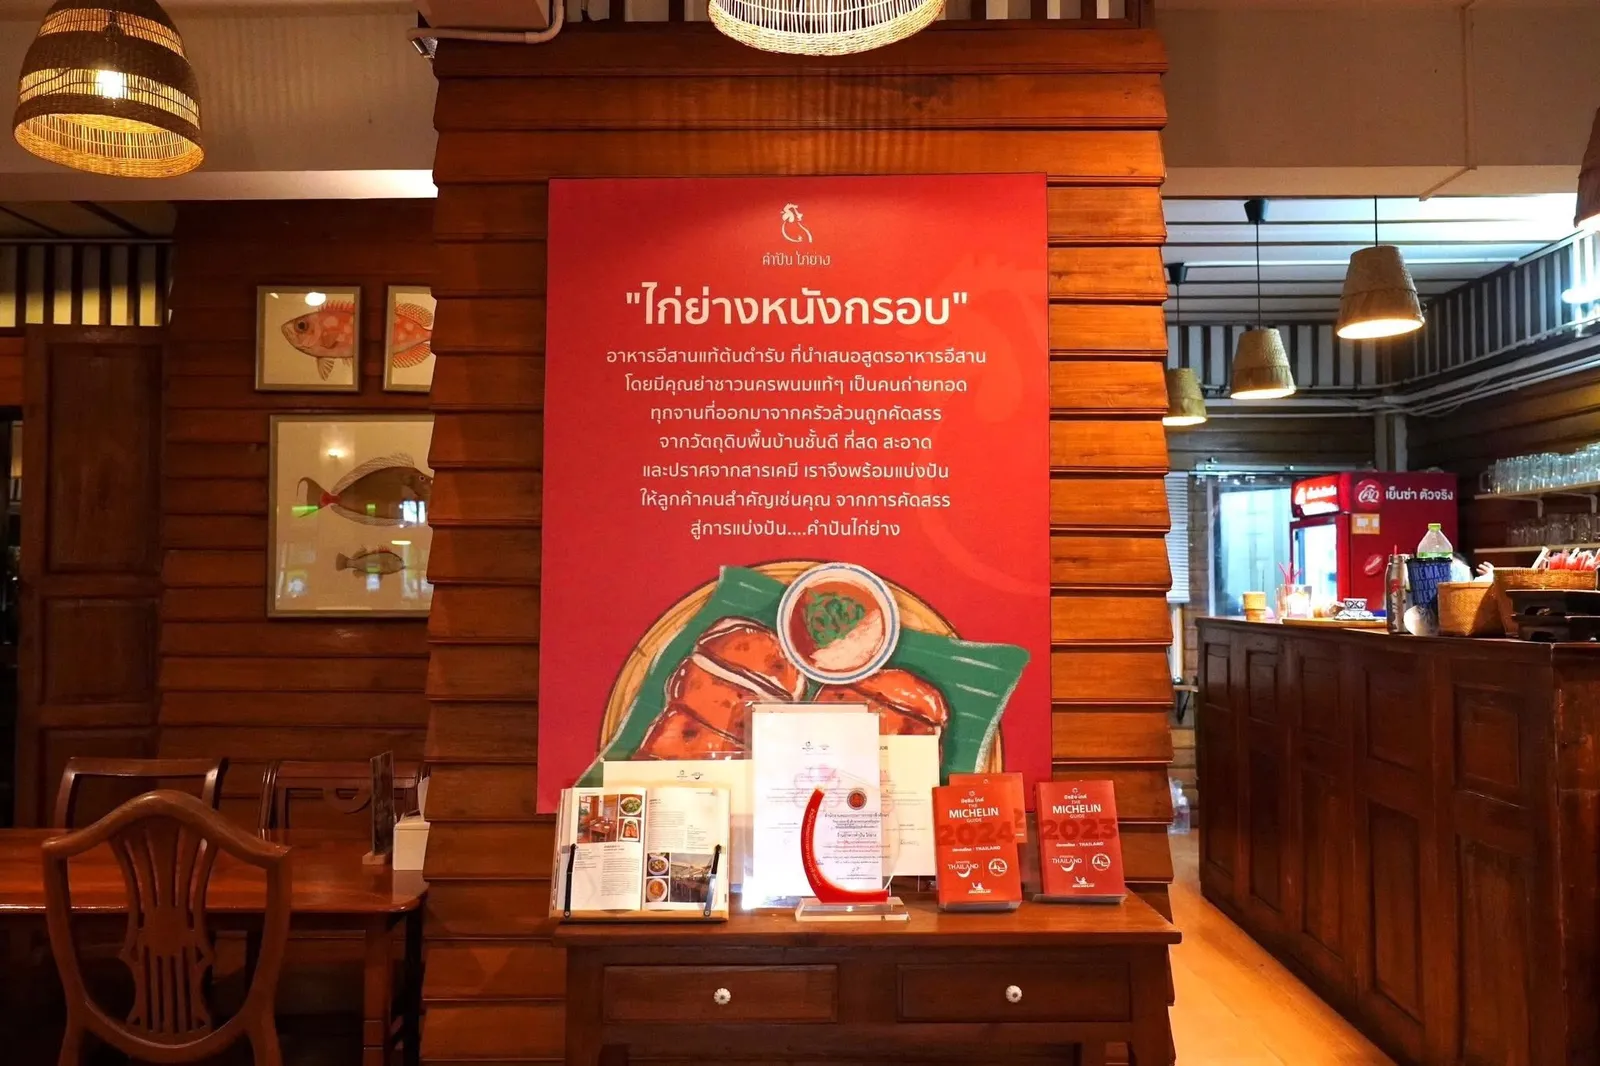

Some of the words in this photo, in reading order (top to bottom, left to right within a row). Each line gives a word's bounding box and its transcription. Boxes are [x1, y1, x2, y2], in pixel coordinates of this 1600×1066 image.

[625, 281, 968, 326] "ไก่ย่างหนังกรอบ"
[606, 346, 785, 364] อาหารอีสานแท้ต้นตำรับ
[790, 343, 987, 368] ที่นำเสนอสูตรอาหารอีสาน
[624, 372, 844, 396] โดยมีคุณย่าชาวนครพนมแท้ๆ
[849, 374, 968, 393] เป็นคนถ่ายทอด
[650, 400, 942, 426] ทุกจานที่ออกมาจากครัวล้วนถูกคัดสรร
[659, 428, 839, 454] จากวัตถุดิบพื้นบ้านชั้นดี
[844, 429, 878, 451] ที่สด
[882, 436, 933, 450] สะอาด
[642, 461, 799, 478] และปราศจากสารเคมี
[804, 461, 949, 479] เราจึงพร้อมแบ่งปัน
[639, 487, 831, 512] ให้ลูกค้าคนสำคัญเช่นคุณ
[835, 491, 951, 508] จากการคัดสรร
[1385, 486, 1417, 500] เย็นซ่า
[1419, 488, 1454, 501] ตัวจริง
[948, 808, 999, 819] MICHELIN
[1052, 804, 1102, 814] MICHELIN
[938, 821, 1015, 845] 2024
[1041, 818, 1118, 841] 2023
